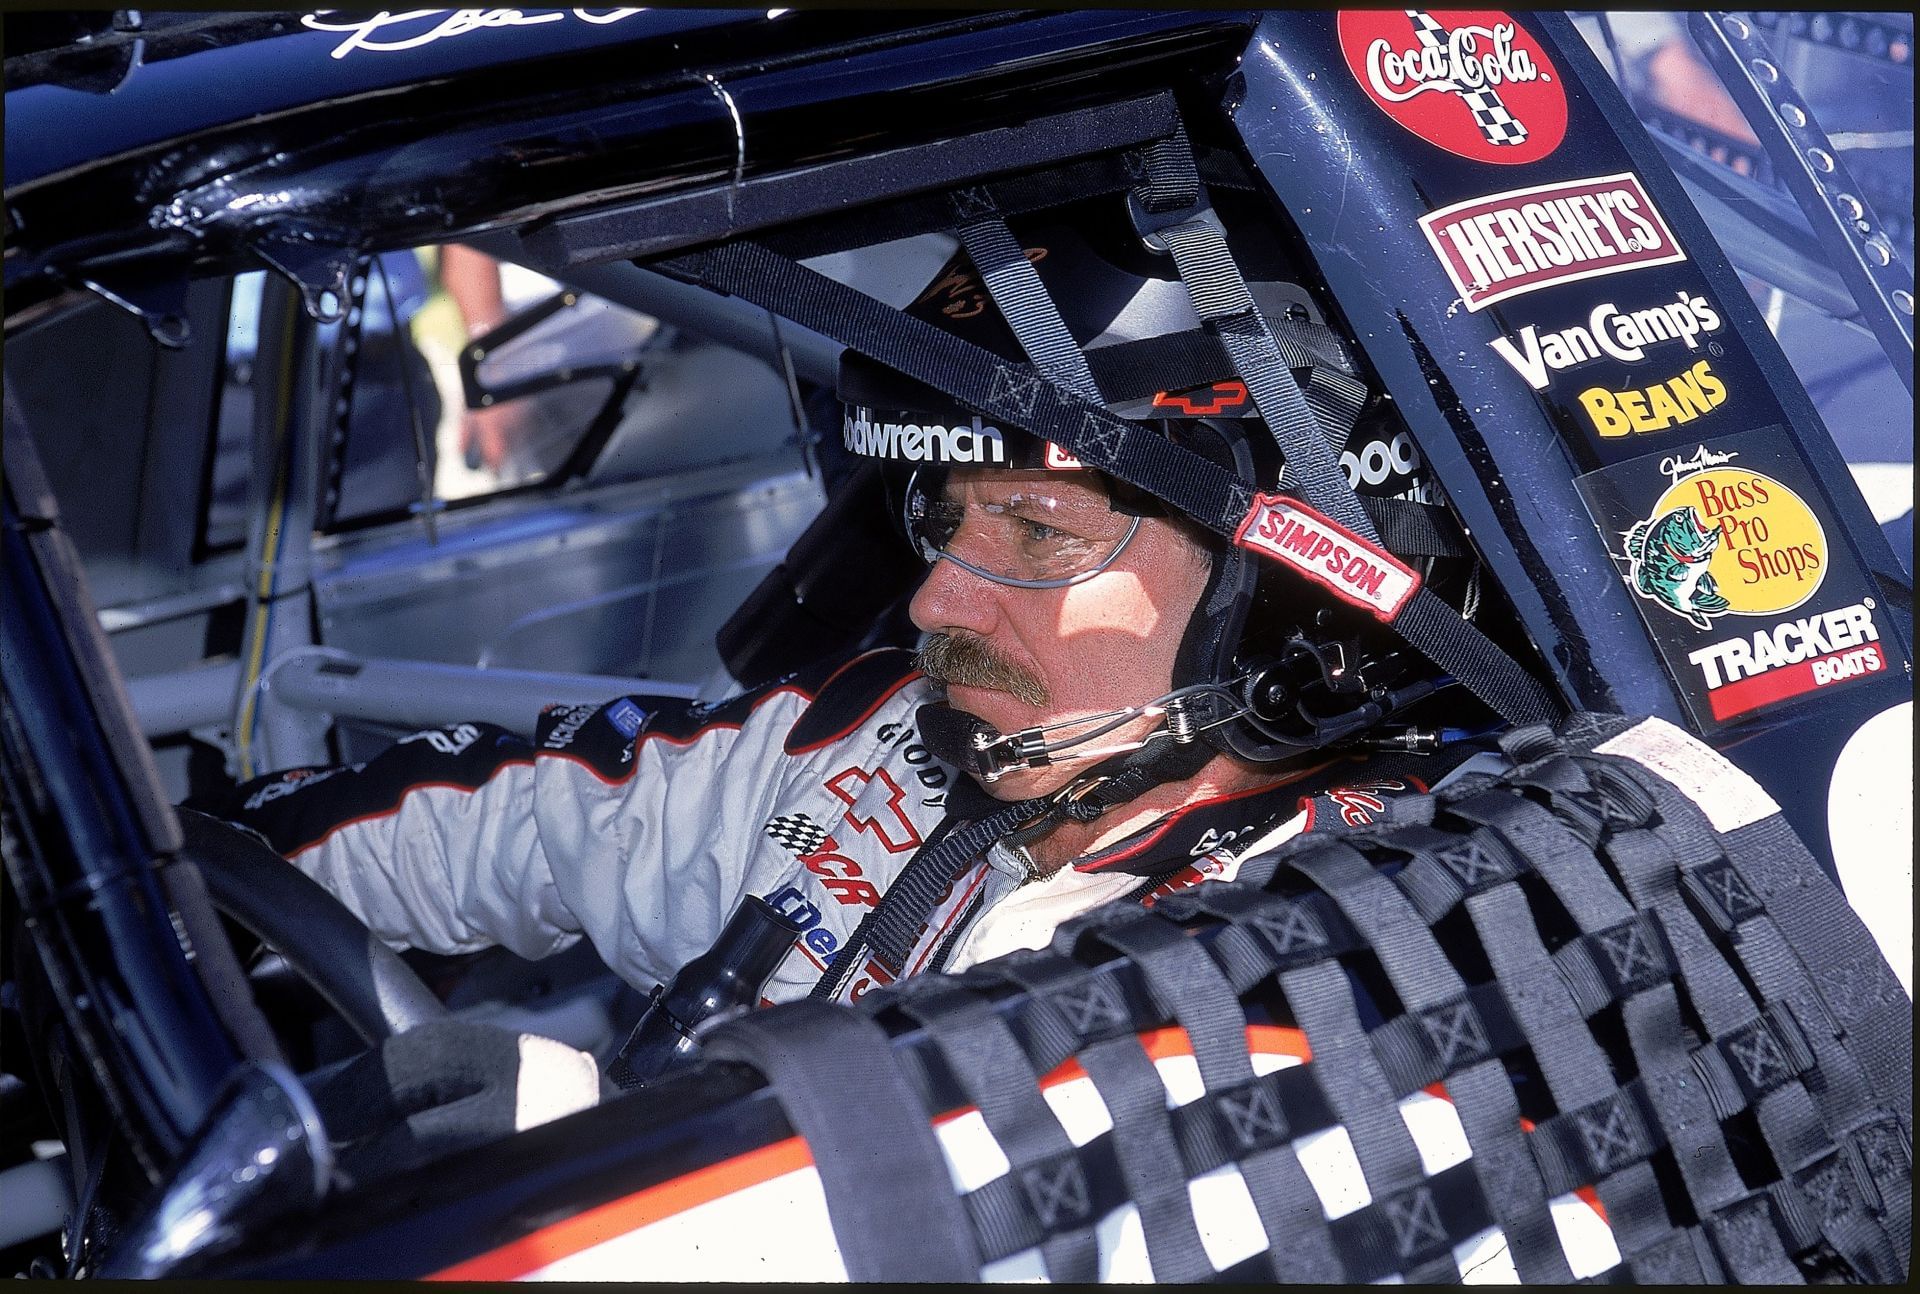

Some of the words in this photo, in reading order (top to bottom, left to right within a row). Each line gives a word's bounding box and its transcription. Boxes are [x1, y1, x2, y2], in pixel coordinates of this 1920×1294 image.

[1366, 23, 1538, 102] Coca-Cola
[1445, 188, 1663, 287] HERSHEY'S
[843, 402, 1005, 463] odwrench
[1578, 360, 1727, 437] BEANS
[1695, 478, 1769, 517] Bass
[1258, 510, 1388, 596] SIMPSON
[1717, 514, 1769, 551] Pro
[1737, 543, 1820, 584] Shops
[1688, 603, 1880, 690] TRACKER
[1811, 647, 1881, 686] BOATS
